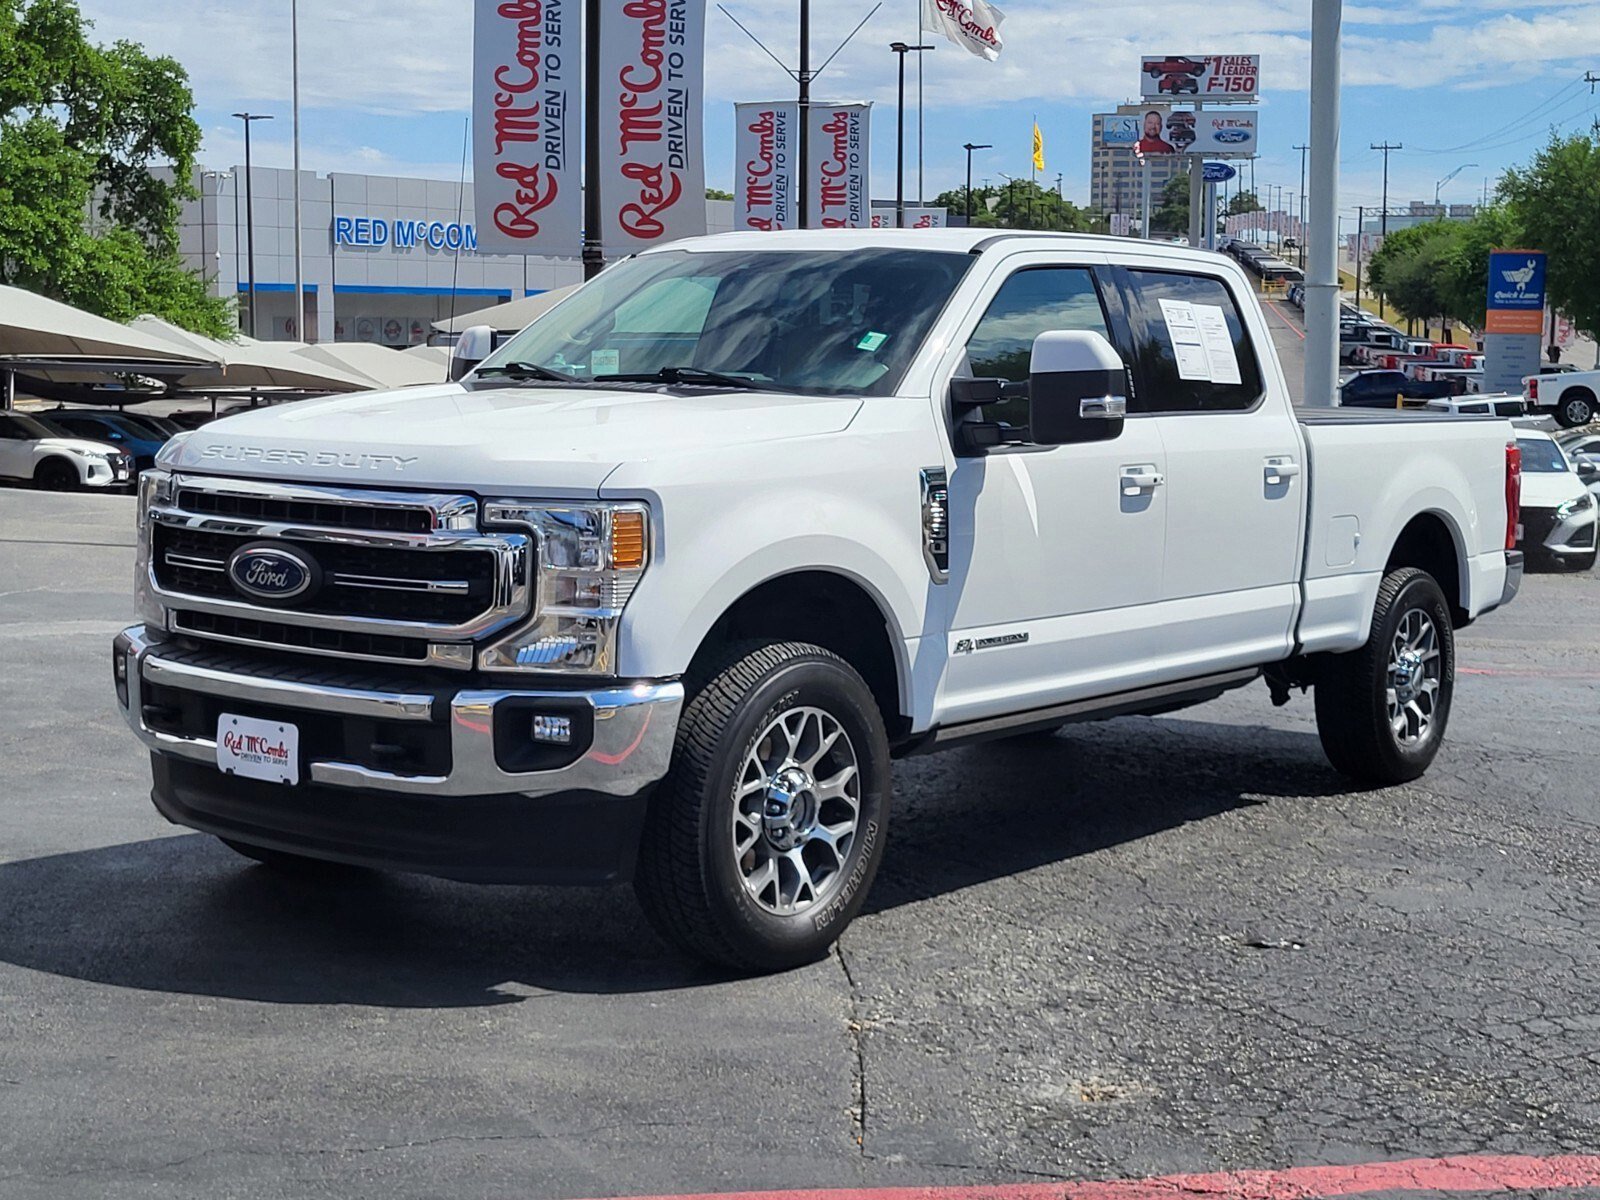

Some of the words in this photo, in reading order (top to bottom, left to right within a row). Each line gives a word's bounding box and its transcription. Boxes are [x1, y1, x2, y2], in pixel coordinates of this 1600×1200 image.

[545, 54, 562, 83] TO
[668, 53, 685, 82] TO
[1204, 56, 1222, 76] #1
[1222, 66, 1258, 76] LEADER
[1223, 56, 1251, 66] SALES
[1206, 77, 1256, 93] F-150
[545, 90, 563, 171] DRIVEN
[668, 88, 687, 170] DRIVEN
[776, 110, 787, 150] SERVE
[850, 111, 861, 150] SERVE
[1219, 131, 1245, 142] Ford
[746, 110, 775, 214] McCombs
[776, 153, 787, 170] TO
[820, 111, 849, 215] McCombs
[850, 154, 861, 171] TO
[493, 162, 559, 239] Red
[619, 162, 682, 239] Red
[776, 174, 789, 222] DRIVEN
[850, 174, 862, 222] DRIVEN
[336, 216, 388, 246] RED
[1494, 290, 1519, 299] Quick
[1519, 290, 1540, 299] Lane
[200, 443, 309, 465] SUPER
[311, 451, 419, 471] DUTY
[245, 557, 289, 588] Ford
[224, 730, 243, 757] Red
[245, 734, 290, 759] McCombs
[241, 752, 262, 762] DRIVEN
[263, 755, 271, 763] TO
[272, 757, 289, 767] SERVE
[814, 819, 880, 932] MICHELIN
